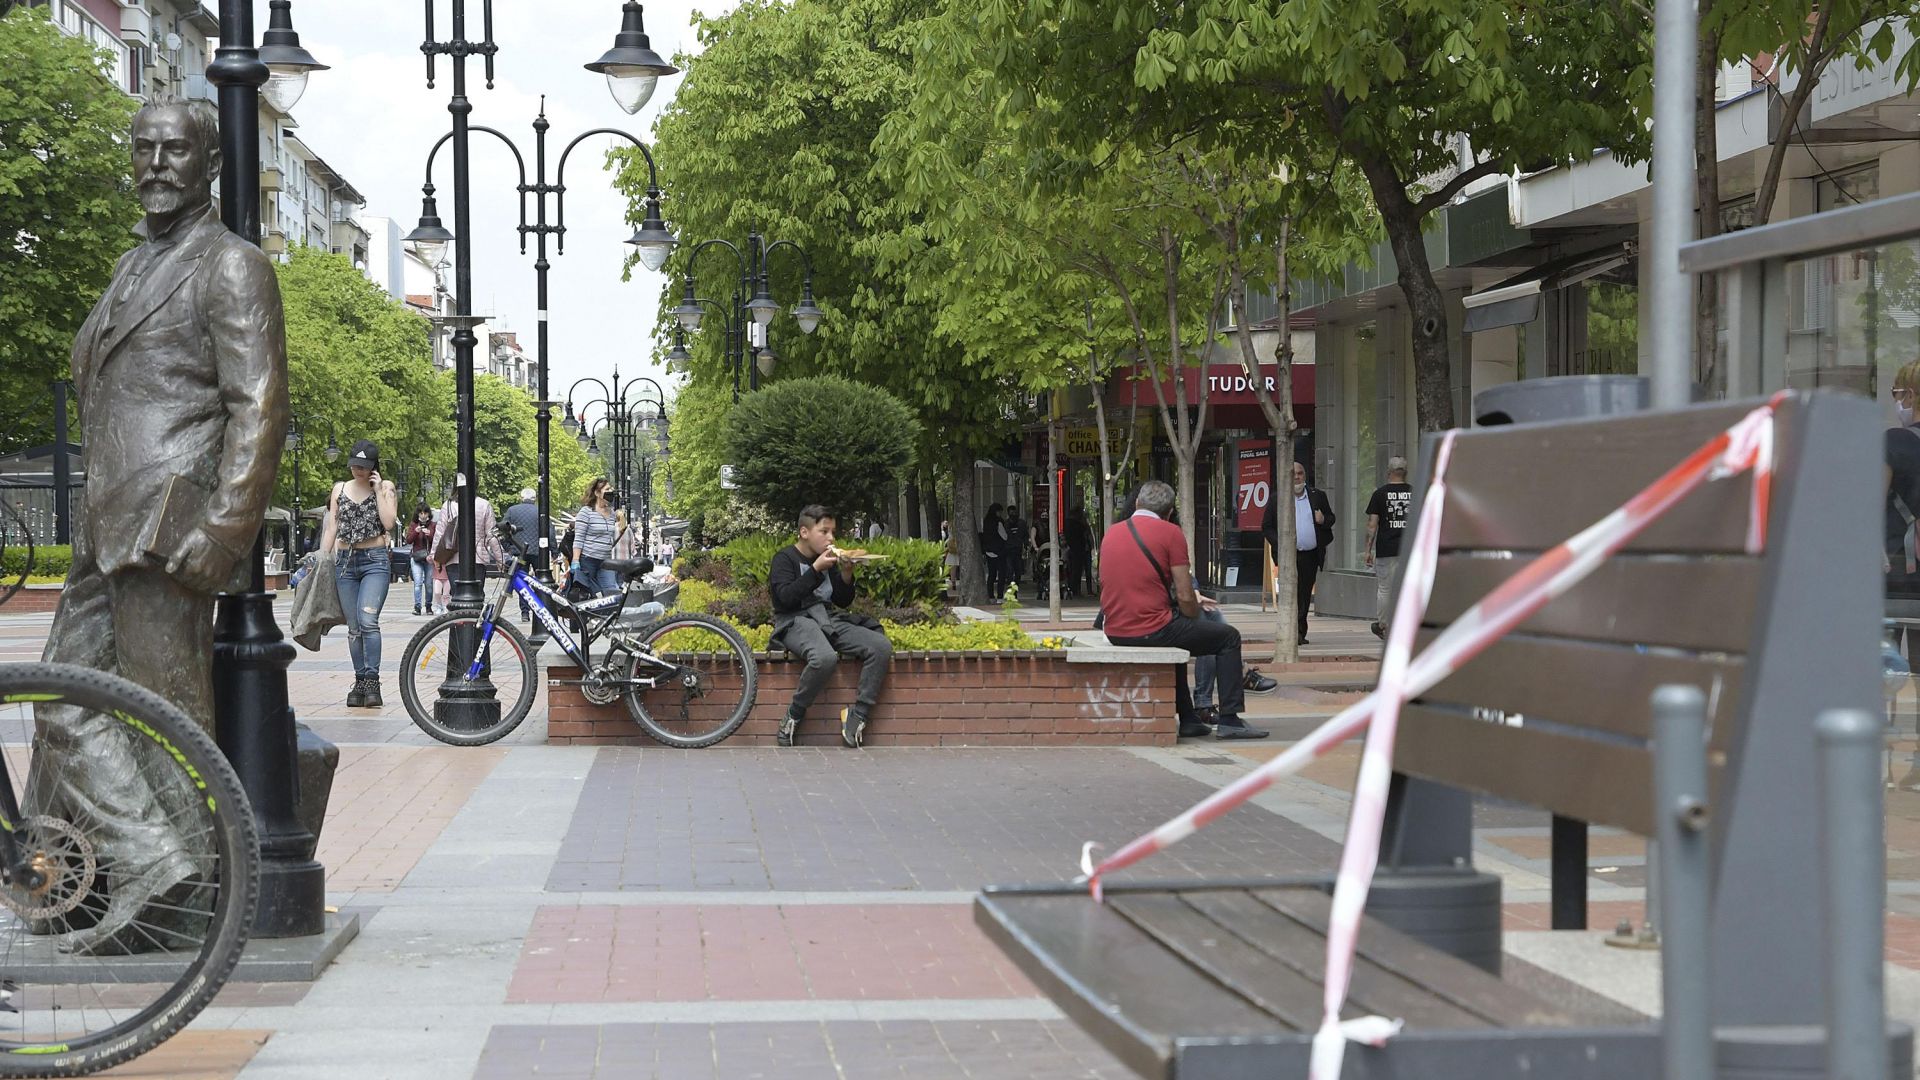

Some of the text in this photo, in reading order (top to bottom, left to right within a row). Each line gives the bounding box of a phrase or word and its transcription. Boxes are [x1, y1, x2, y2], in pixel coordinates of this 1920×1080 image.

[1208, 376, 1279, 392] TUDR
[1068, 431, 1092, 439] Office
[1387, 492, 1412, 500] DO NOT
[1389, 520, 1407, 528] TOUC
[152, 974, 207, 1031] SCHWALBE
